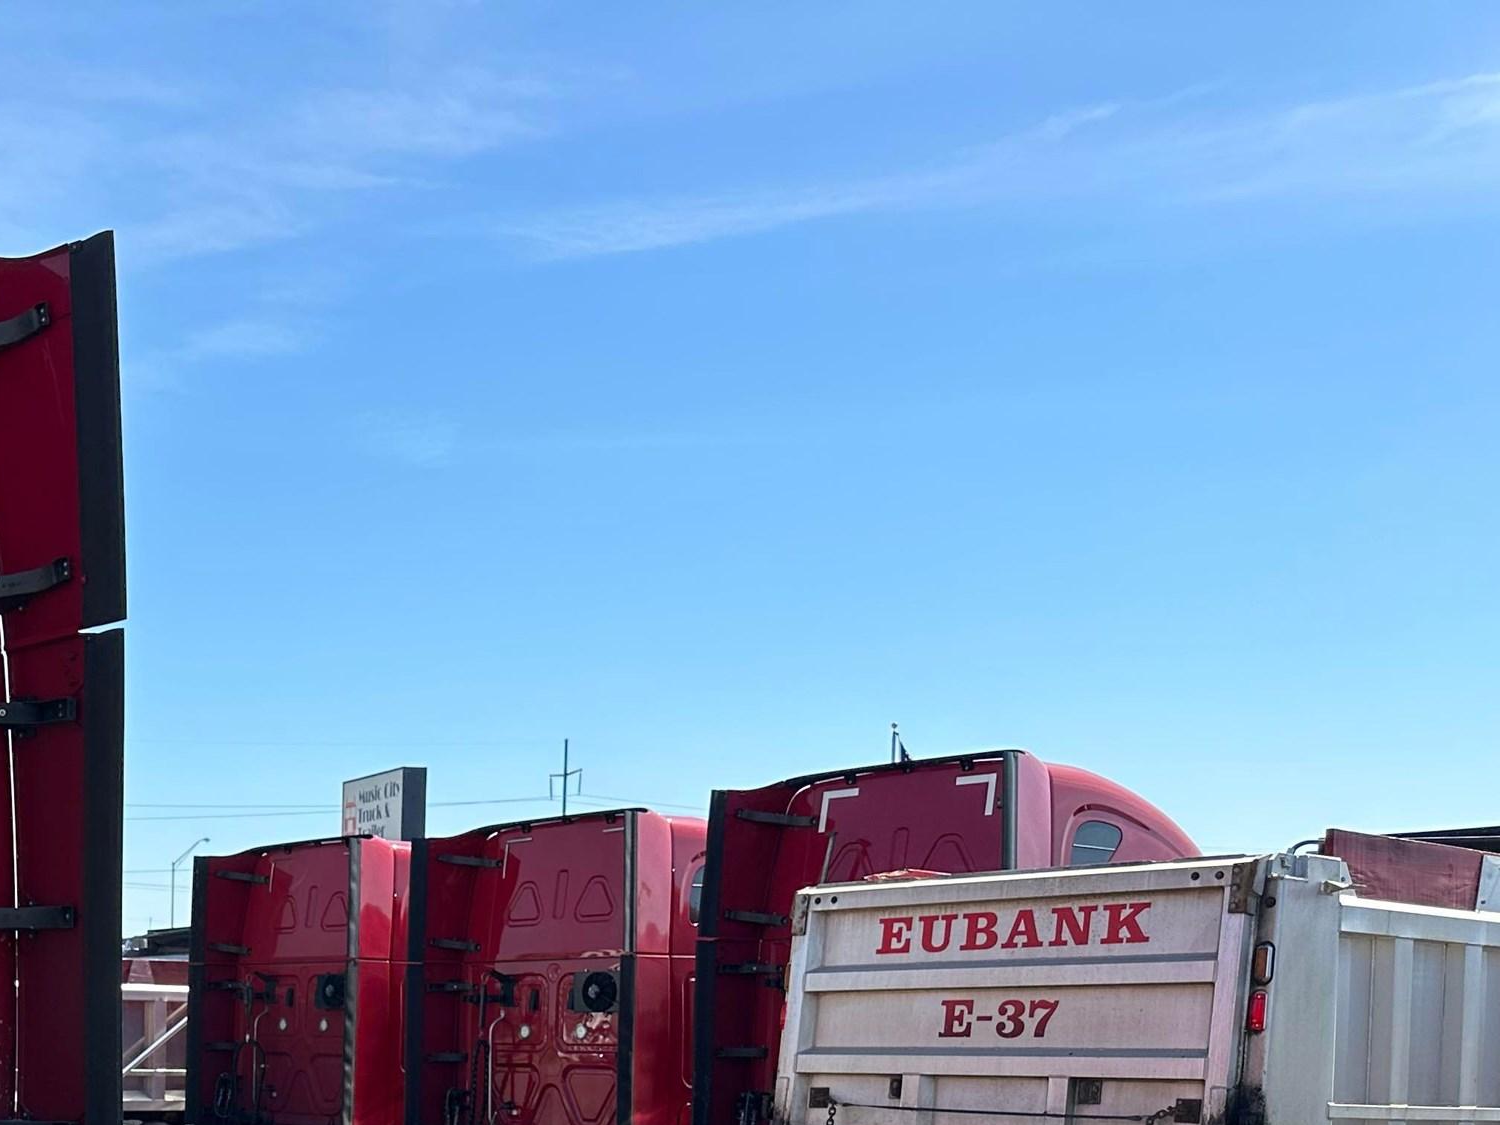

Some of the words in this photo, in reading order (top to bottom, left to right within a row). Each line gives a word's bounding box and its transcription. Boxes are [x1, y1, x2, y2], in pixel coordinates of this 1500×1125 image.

[358, 785, 381, 803] Music
[384, 781, 400, 798] City
[358, 805, 382, 824] Truck
[876, 902, 1152, 955] EUBANK
[938, 998, 1059, 1038] E-37
